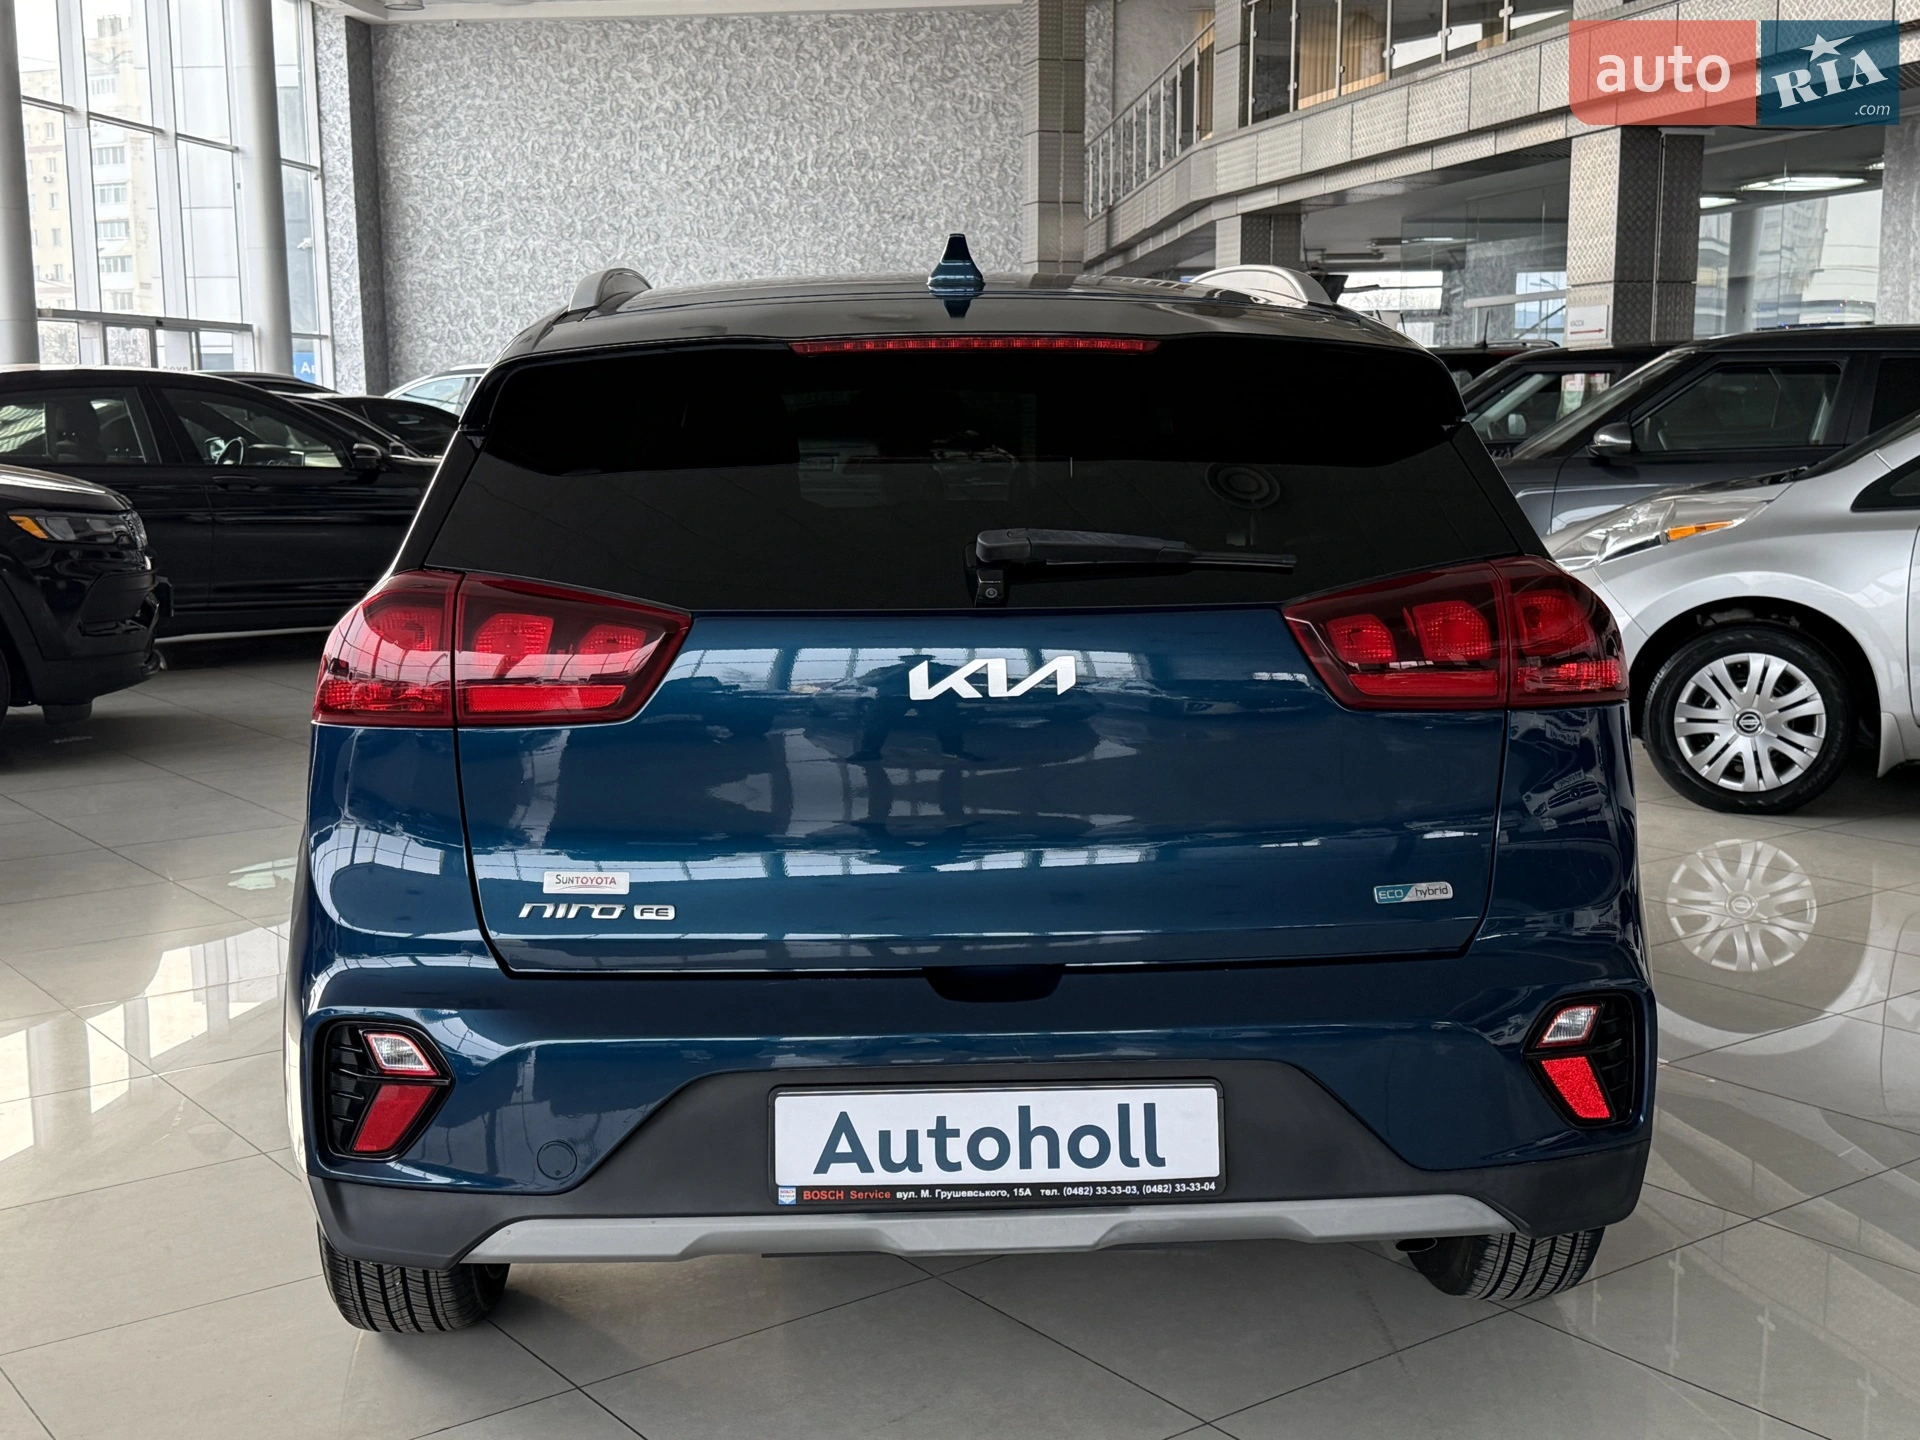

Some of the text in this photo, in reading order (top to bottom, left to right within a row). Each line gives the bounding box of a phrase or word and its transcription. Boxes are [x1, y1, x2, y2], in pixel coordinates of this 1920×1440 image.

[909, 655, 1077, 700] KIA
[1378, 885, 1449, 900] ECO hybrid
[639, 907, 670, 917] FE
[813, 1103, 1167, 1175] Autoholl
[803, 1190, 844, 1200] BOSCH
[850, 1190, 891, 1200] Service
[896, 1190, 918, 1200] вул.
[920, 1189, 932, 1198] М.
[935, 1188, 1010, 1200] Грушевського,
[1040, 1188, 1060, 1196] тел.
[1063, 1186, 1093, 1197] (0482)
[1095, 1185, 1140, 1196] 33-33-03,
[1142, 1183, 1172, 1195] (0482)
[1175, 1181, 1216, 1193] 33-33-04
